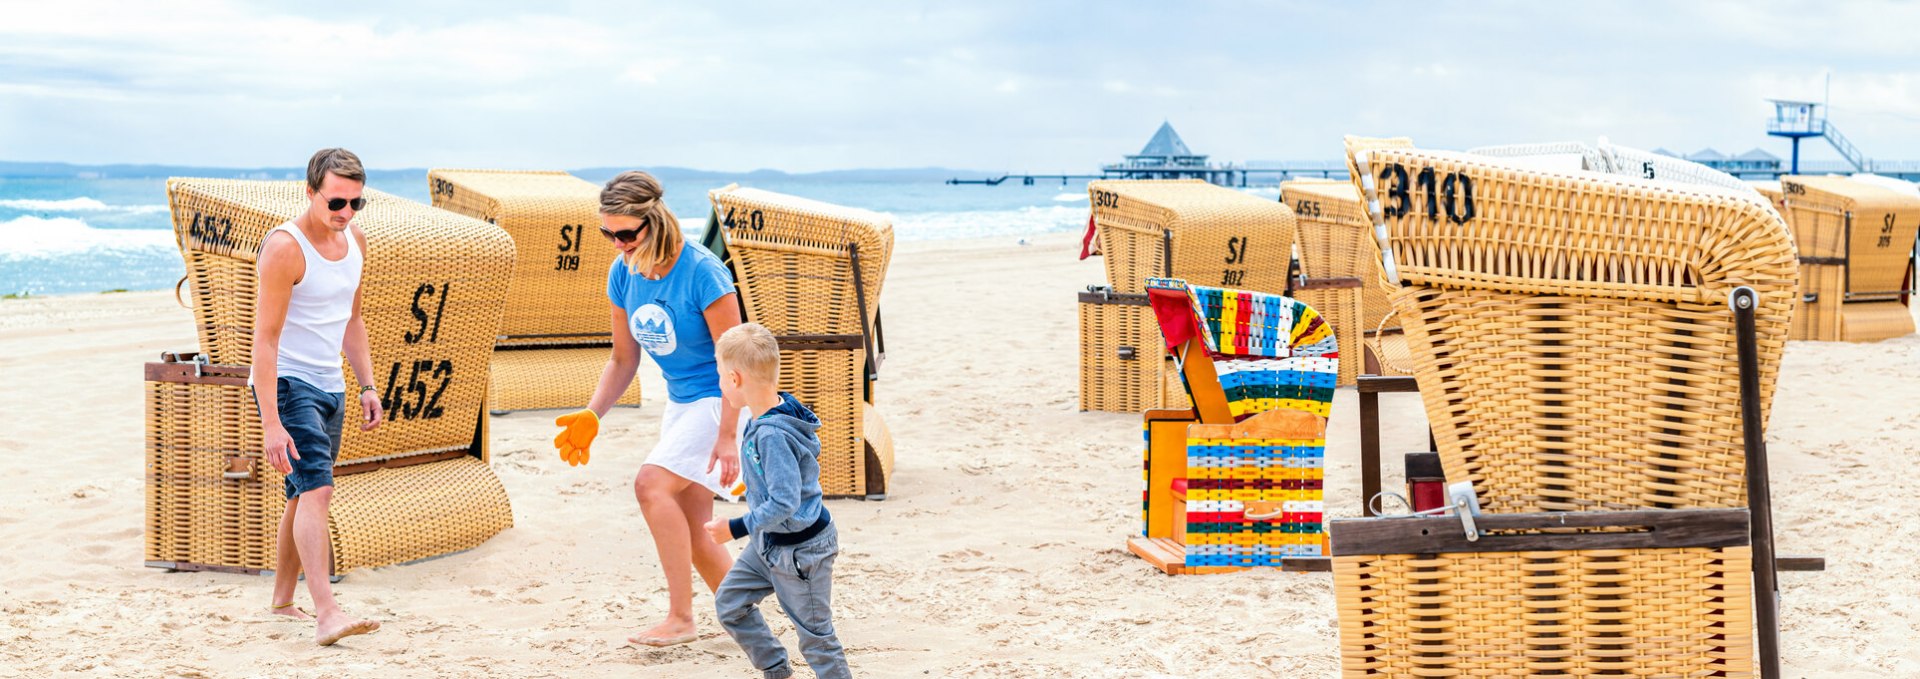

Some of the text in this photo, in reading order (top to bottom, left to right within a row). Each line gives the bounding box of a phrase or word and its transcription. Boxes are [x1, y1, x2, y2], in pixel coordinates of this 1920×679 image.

[434, 177, 454, 199] 309
[1095, 190, 1119, 209] 302
[1379, 162, 1477, 226] 310
[1786, 182, 1806, 196] 305
[1296, 199, 1321, 217] 455
[189, 211, 232, 246] 452
[557, 224, 583, 252] SI
[554, 254, 580, 271] 309
[1225, 236, 1247, 264] SI
[1221, 269, 1245, 286] 302
[404, 282, 449, 344] SI
[381, 360, 453, 422] 452
